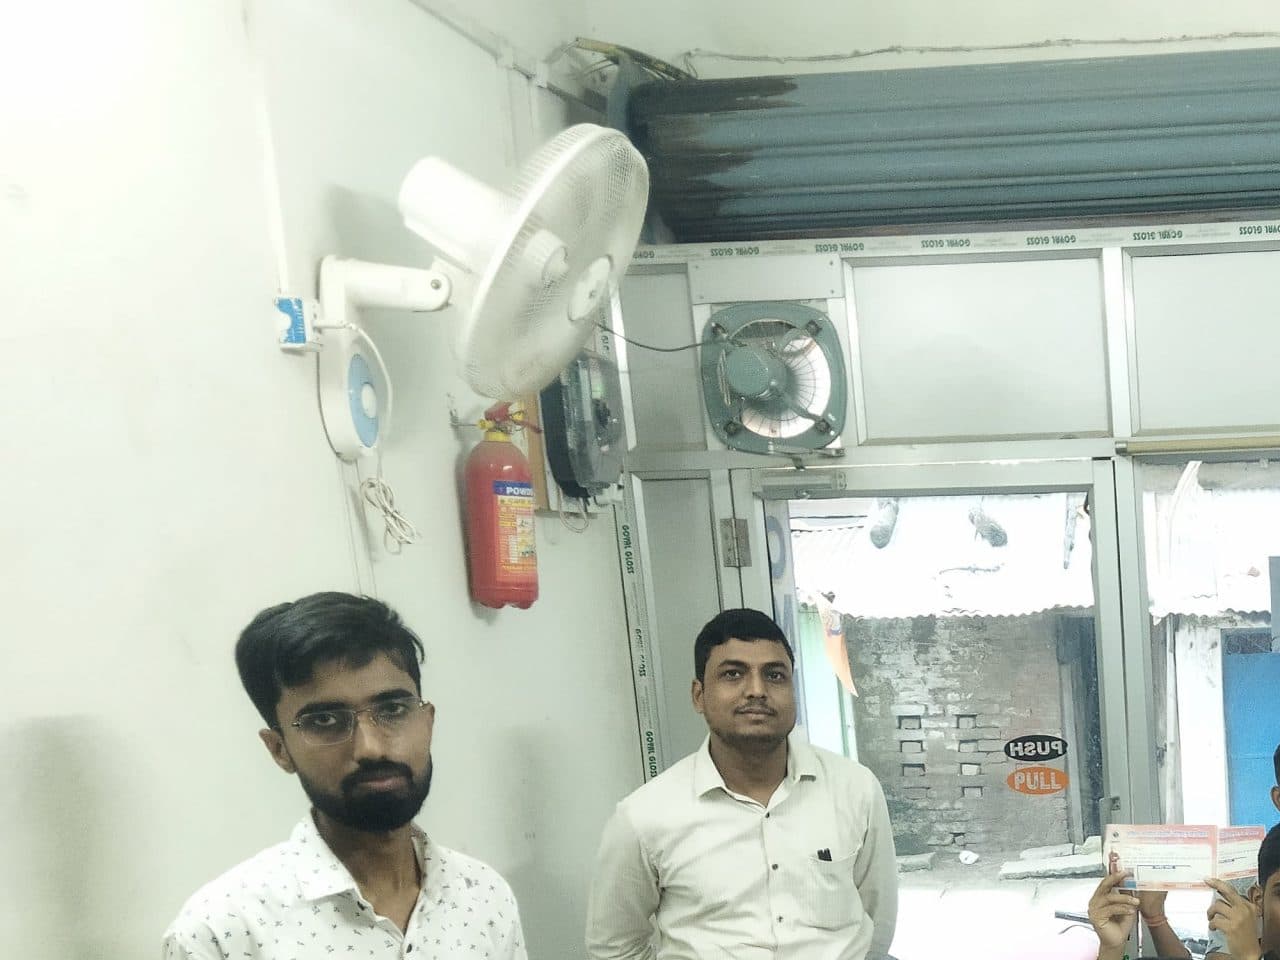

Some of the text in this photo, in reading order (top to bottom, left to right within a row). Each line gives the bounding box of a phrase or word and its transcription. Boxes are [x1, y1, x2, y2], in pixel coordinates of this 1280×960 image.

[1239, 226, 1262, 235] GLOSS
[946, 240, 971, 248] GOYAL
[1026, 234, 1076, 245] GOYAL GLOSS
[710, 246, 760, 258] GOYAL GLOSS
[816, 243, 865, 254] GOYAL GLOSS
[622, 524, 634, 574] GOYAL GLOSS
[646, 730, 658, 778] GOYAL GLOSS
[1014, 772, 1062, 790] PULL
